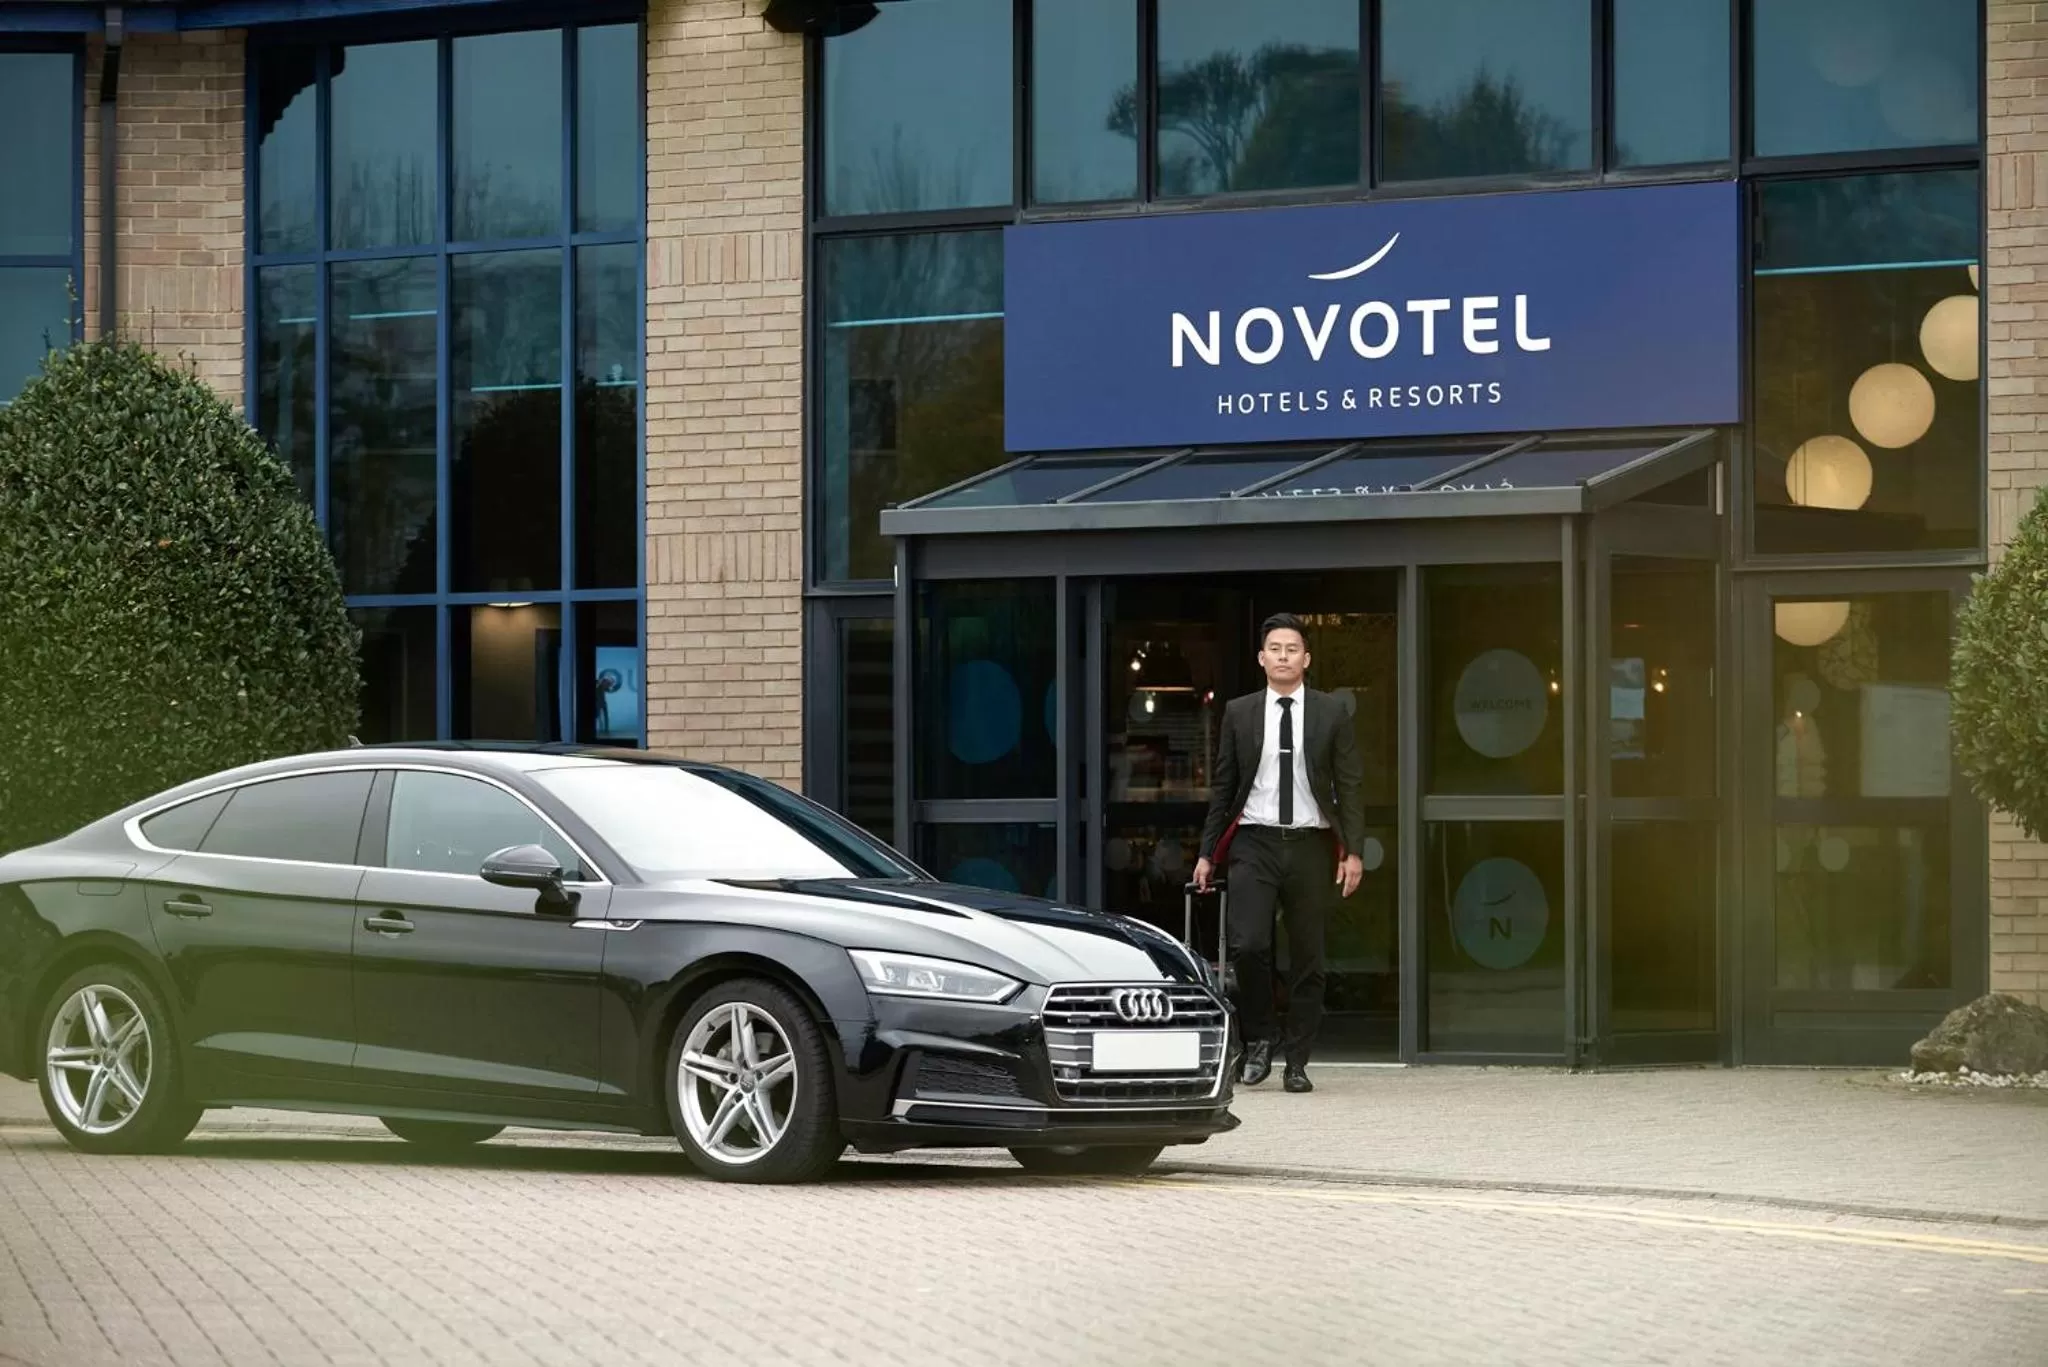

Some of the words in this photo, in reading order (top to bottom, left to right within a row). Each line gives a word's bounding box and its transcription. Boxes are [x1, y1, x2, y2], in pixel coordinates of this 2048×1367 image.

[1172, 294, 1551, 368] NOVOTEL
[1217, 389, 1330, 415] HOTELS
[1341, 388, 1358, 411] &
[1369, 382, 1503, 408] RESORTS
[1489, 916, 1512, 940] N
